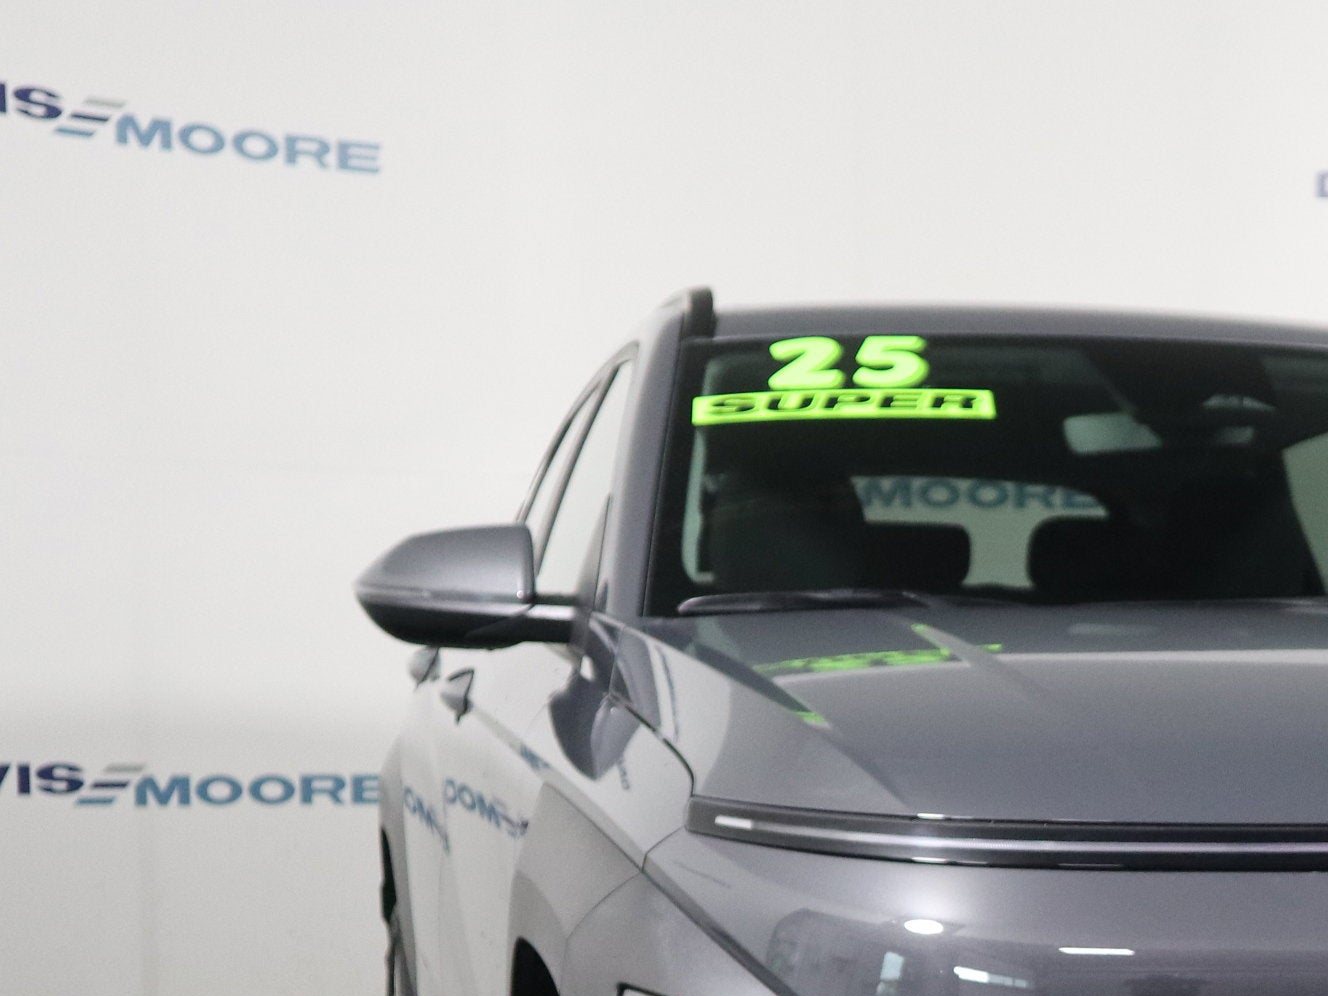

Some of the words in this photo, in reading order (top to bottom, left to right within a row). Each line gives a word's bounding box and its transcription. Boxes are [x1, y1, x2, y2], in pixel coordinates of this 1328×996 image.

[115, 113, 382, 174] MOORE
[768, 336, 929, 389] 25
[705, 389, 980, 415] SUPER
[0, 762, 83, 795] IS
[135, 773, 380, 808] MOORE
